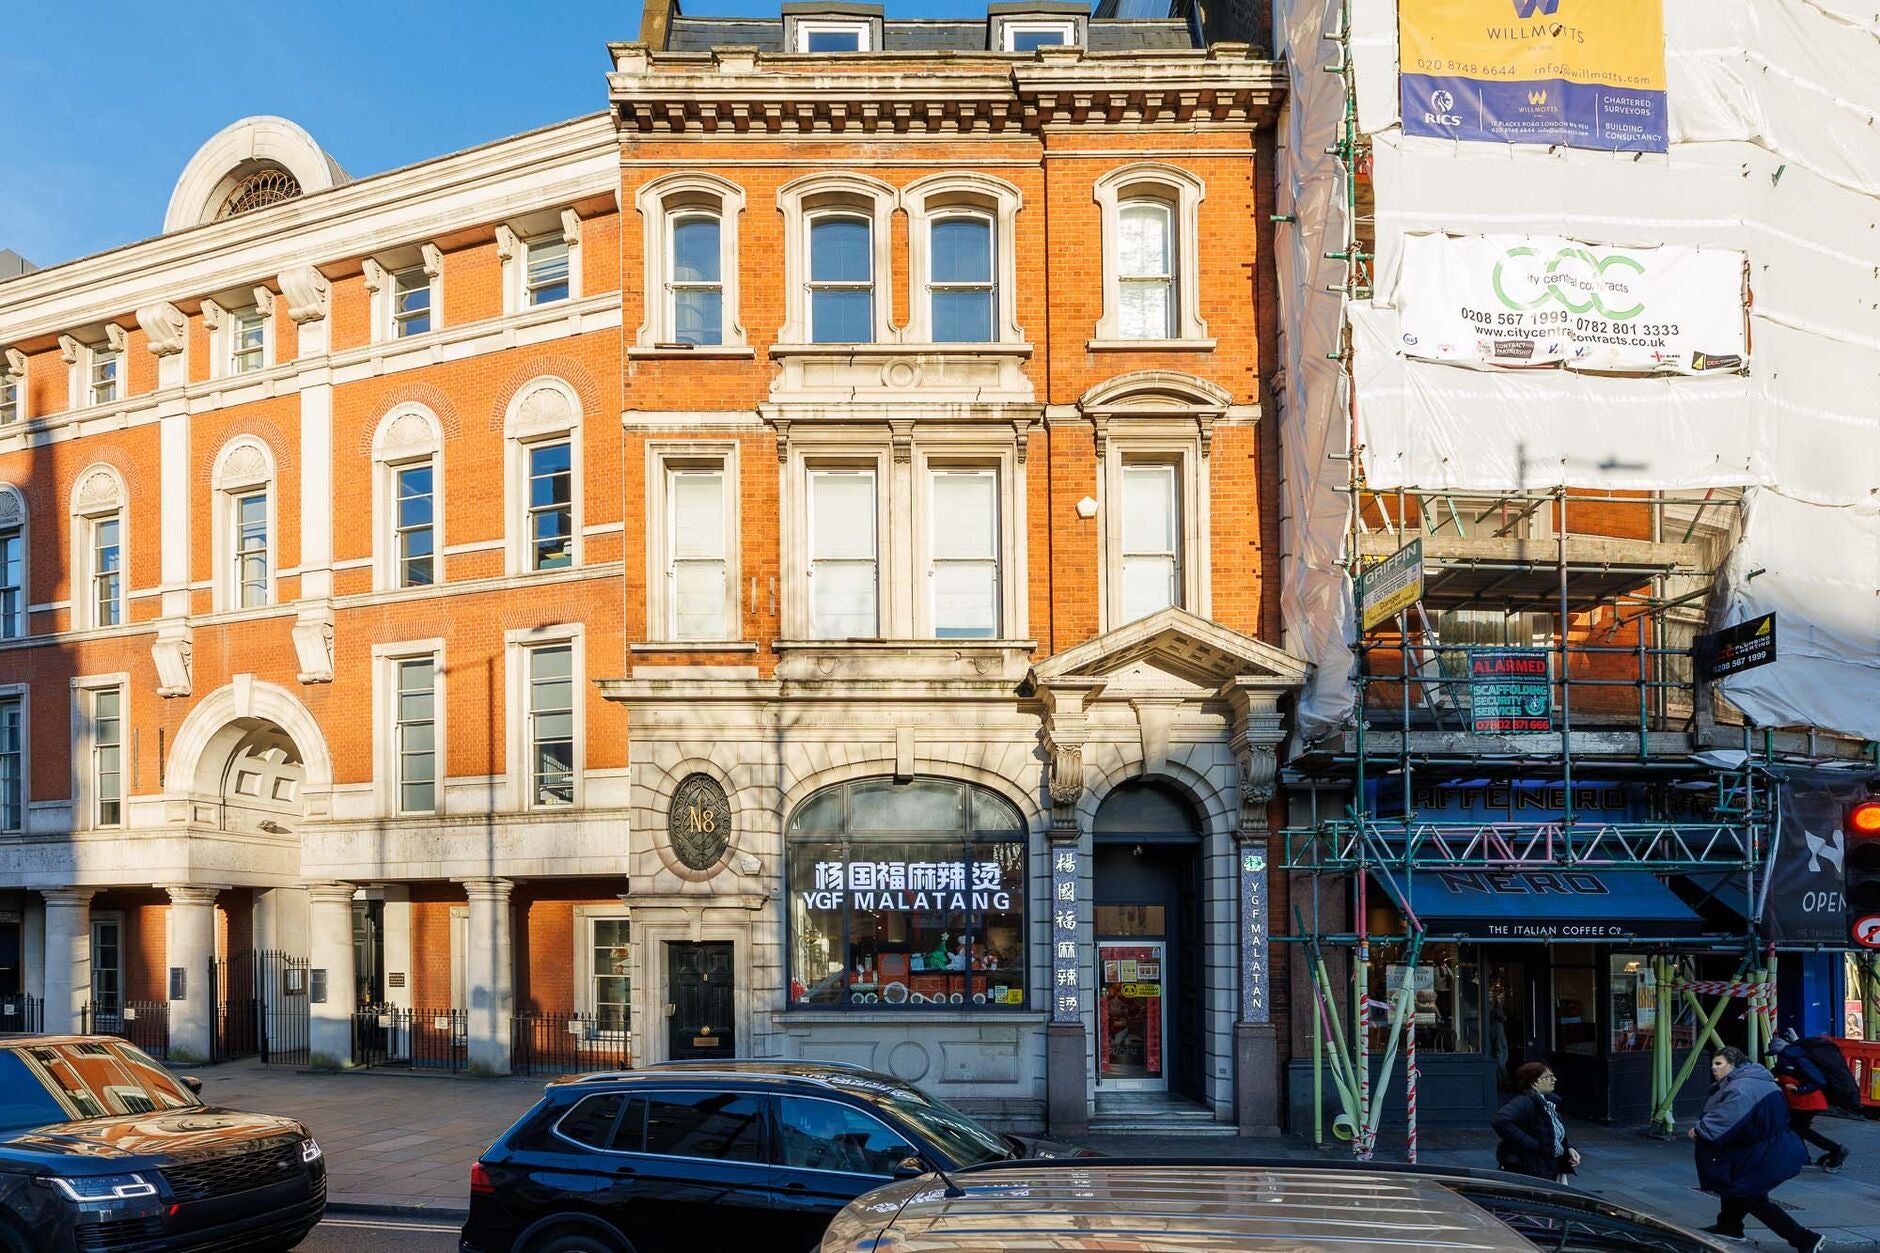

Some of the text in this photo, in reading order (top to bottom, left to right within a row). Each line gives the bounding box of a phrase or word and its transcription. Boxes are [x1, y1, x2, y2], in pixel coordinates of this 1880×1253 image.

[1417, 58, 1442, 71] 020
[1448, 61, 1477, 74] 8748
[1482, 65, 1516, 76] 6644
[1604, 96, 1651, 107] CHARTERED
[1604, 105, 1651, 116] SURVEYORS
[1424, 112, 1462, 126] RICS
[1605, 122, 1643, 133] BUILDING
[1605, 131, 1662, 142] CONSULTANCY
[1461, 307, 1492, 325] 0208
[1497, 313, 1524, 325] 567
[1576, 317, 1608, 334] 0782
[1612, 323, 1637, 336] 801
[1643, 324, 1680, 336] 3333
[1365, 542, 1417, 584] GRIFFIN
[1734, 635, 1771, 650] PLUMBING
[1747, 650, 1767, 662] 1999
[1473, 659, 1546, 673] ALARMED
[1473, 685, 1548, 695] SCAFFOLDING
[1474, 696, 1522, 706] SECURITY
[1474, 706, 1522, 716] SERVICES
[1518, 788, 1628, 810] NERO
[815, 861, 1001, 890] 杨国福麻辣烫
[1437, 871, 1610, 895] NERO
[802, 892, 1010, 910] YGF MALATANG
[1488, 925, 1509, 935] THE
[1514, 925, 1557, 936] ITALIAN
[1562, 925, 1605, 936] COFFEE
